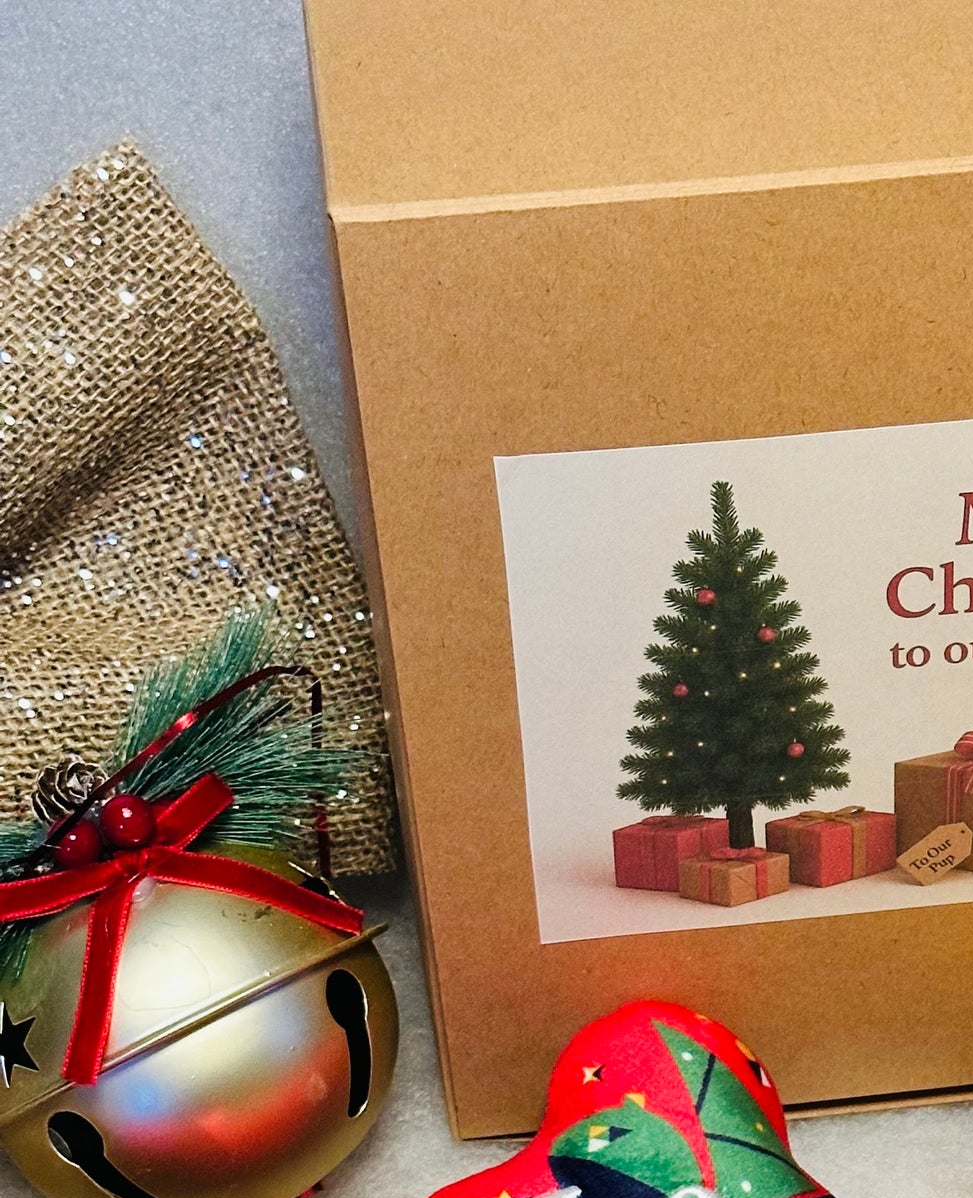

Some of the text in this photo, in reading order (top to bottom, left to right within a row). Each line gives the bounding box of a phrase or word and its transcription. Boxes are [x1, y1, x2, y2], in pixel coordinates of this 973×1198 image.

[890, 642, 931, 669] to
[909, 839, 952, 870] To Our
[928, 855, 955, 873] Pup
